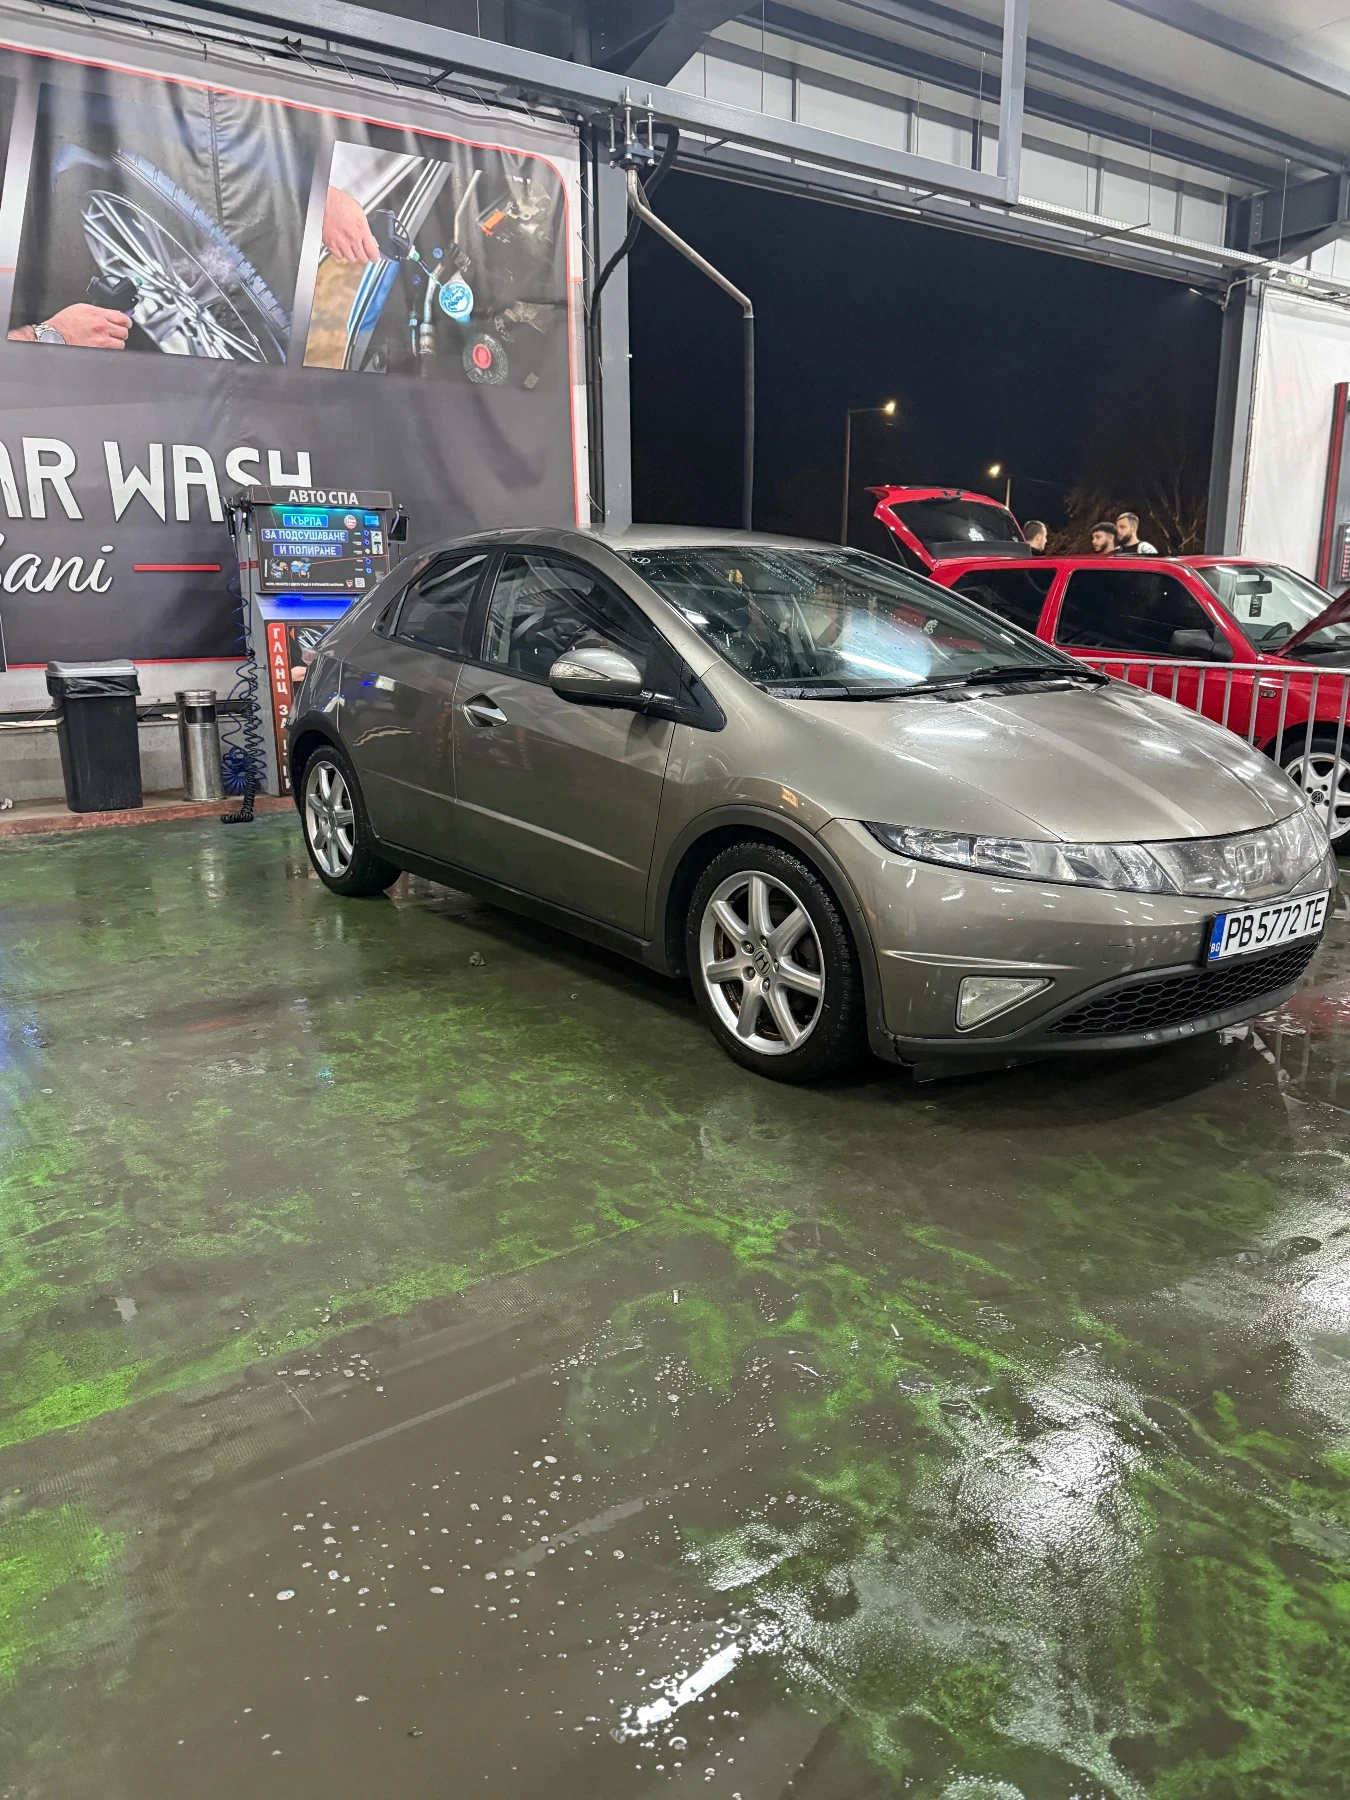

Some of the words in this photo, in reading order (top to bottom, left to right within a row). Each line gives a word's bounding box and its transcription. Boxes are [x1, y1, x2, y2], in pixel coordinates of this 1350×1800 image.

[289, 489, 326, 503] АВТО
[328, 491, 359, 505] СПА
[290, 515, 322, 526] КЪРПА
[264, 530, 277, 539] ЗА
[279, 530, 346, 541] ПОДСУШАВАНЕ
[280, 545, 287, 555] И
[289, 545, 337, 556] ПОЛИРАНЕ
[0, 533, 114, 593] ani
[273, 627, 288, 695] ГЛАНЦ
[1225, 914, 1254, 951] PB
[1255, 904, 1302, 943] 5772
[1303, 897, 1325, 931] TE
[1210, 942, 1221, 953] BG
